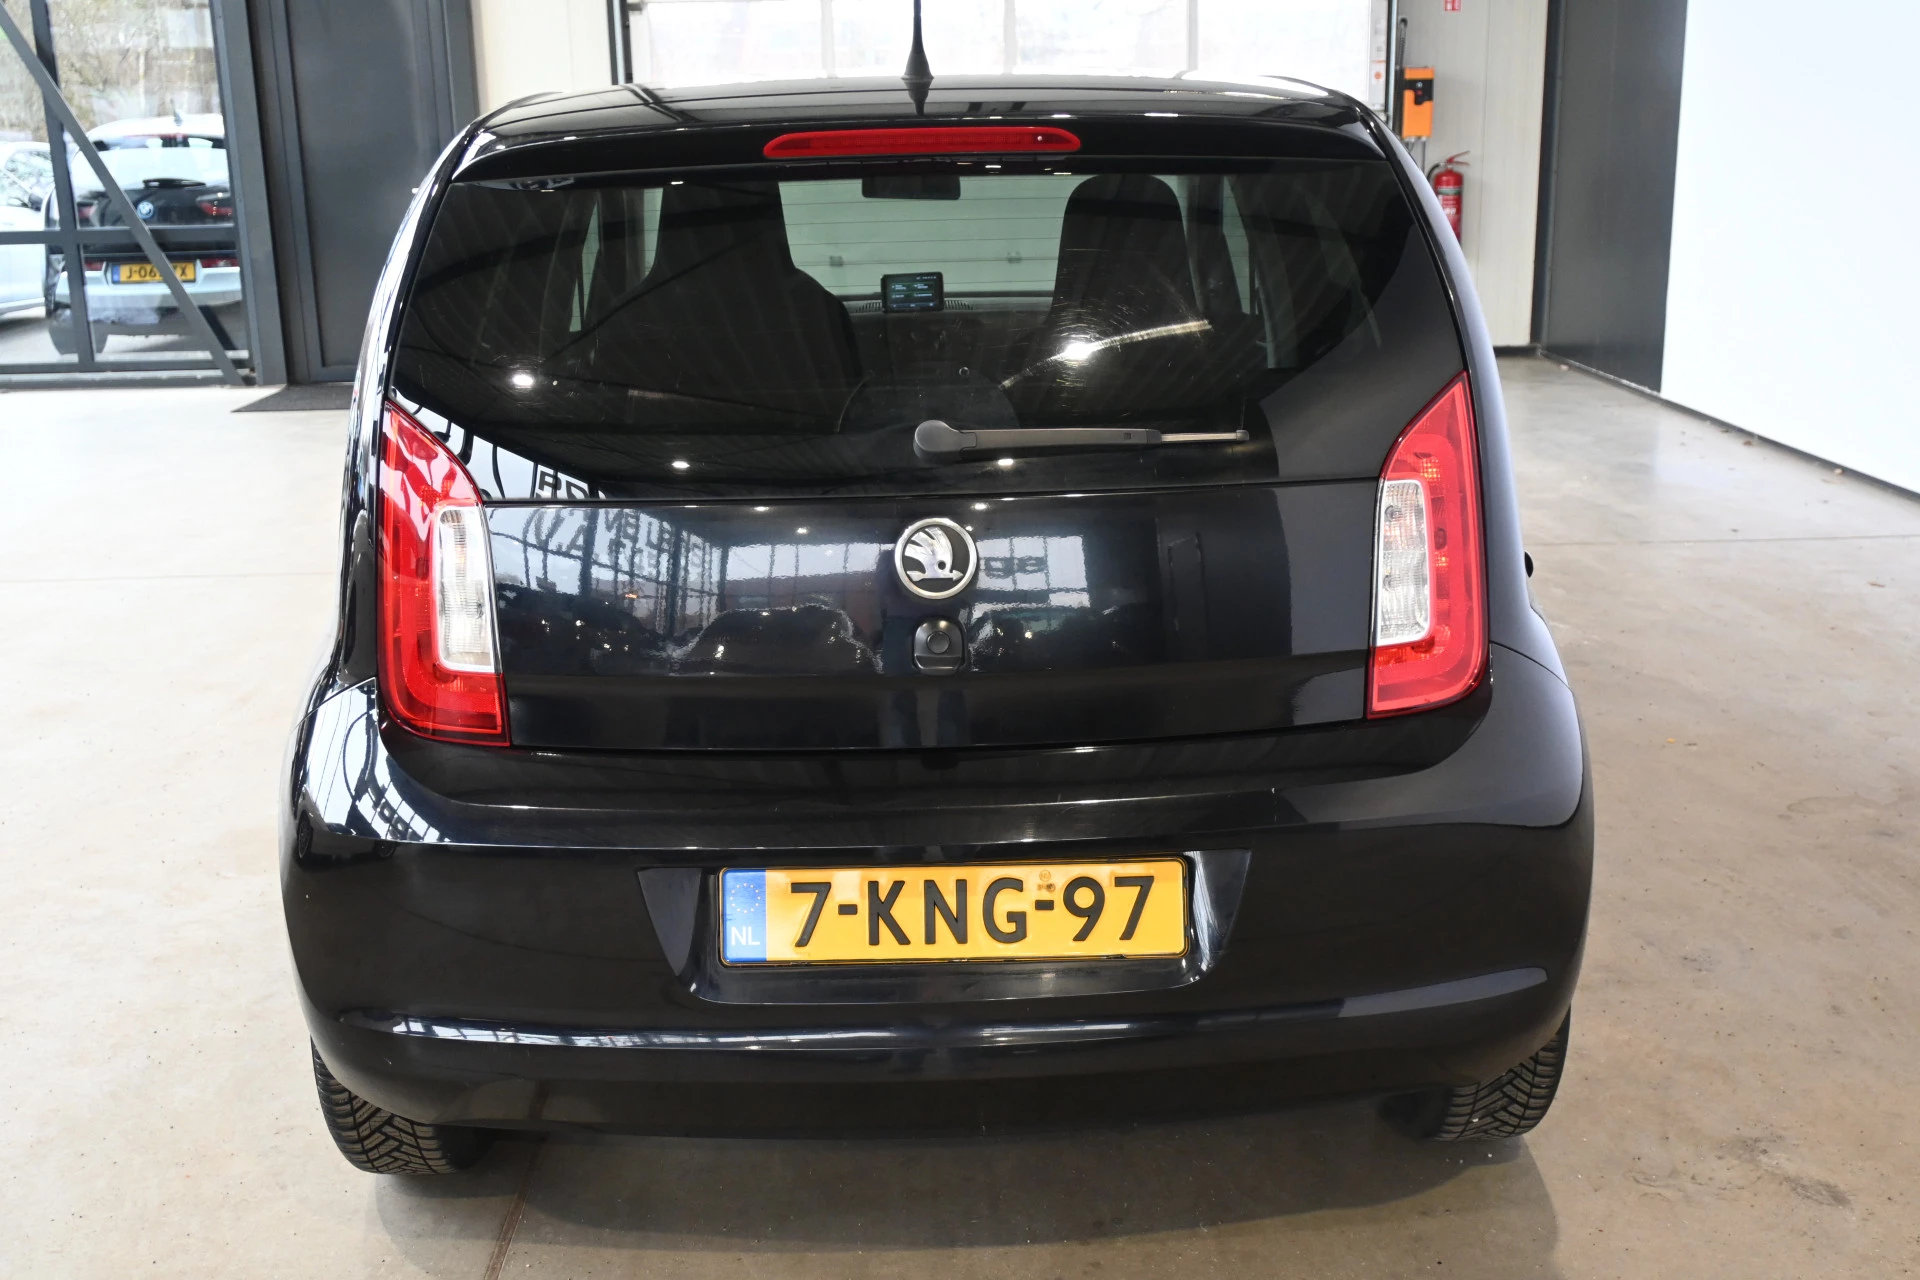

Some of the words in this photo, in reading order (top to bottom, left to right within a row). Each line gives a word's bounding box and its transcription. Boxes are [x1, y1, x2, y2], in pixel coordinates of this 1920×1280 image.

[126, 264, 188, 279] J-06X
[790, 875, 1155, 948] 7-KNG-97
[731, 926, 761, 946] NL
